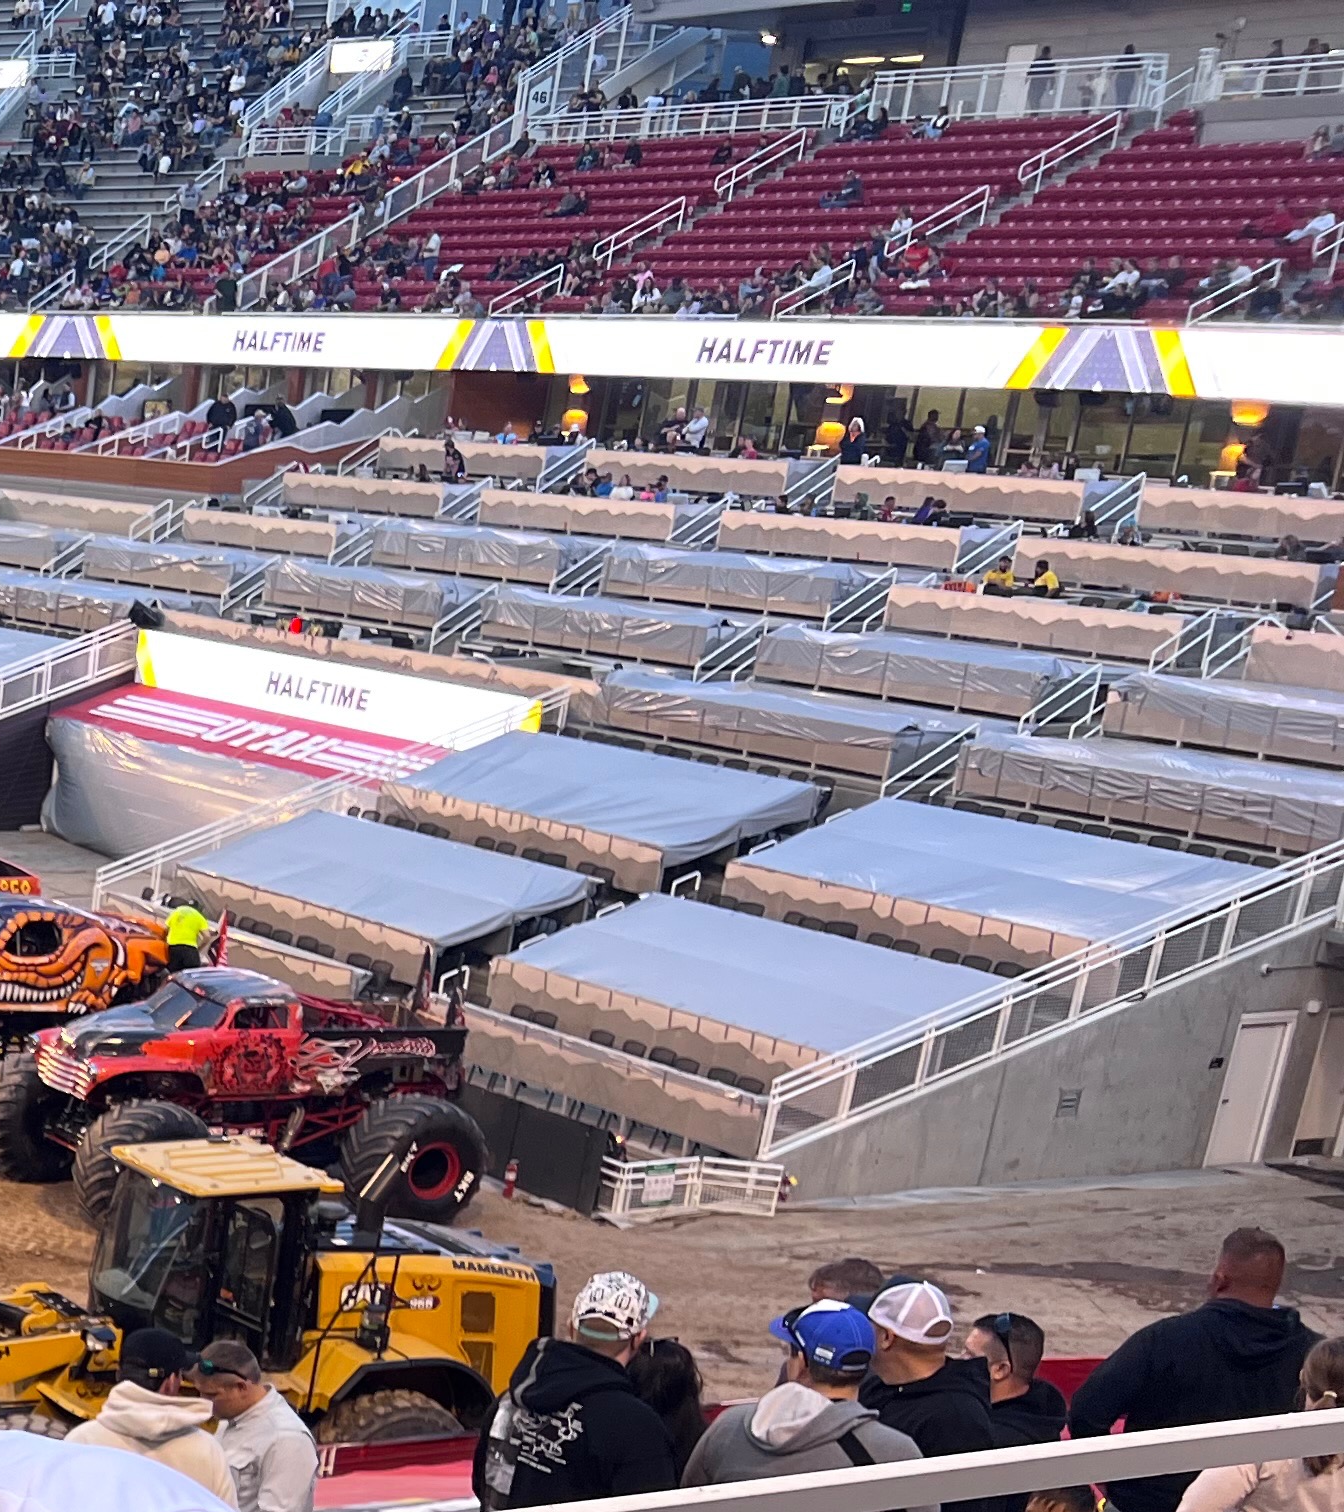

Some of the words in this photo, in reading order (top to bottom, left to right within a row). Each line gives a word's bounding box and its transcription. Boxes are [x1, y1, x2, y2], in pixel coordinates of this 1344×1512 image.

[531, 91, 548, 104] 46
[232, 330, 326, 353] HALFTIME
[695, 336, 835, 366] HALFTIME
[265, 670, 372, 711] HALFTIME
[201, 717, 343, 762] UTAH
[452, 1259, 537, 1282] MAMMOTH
